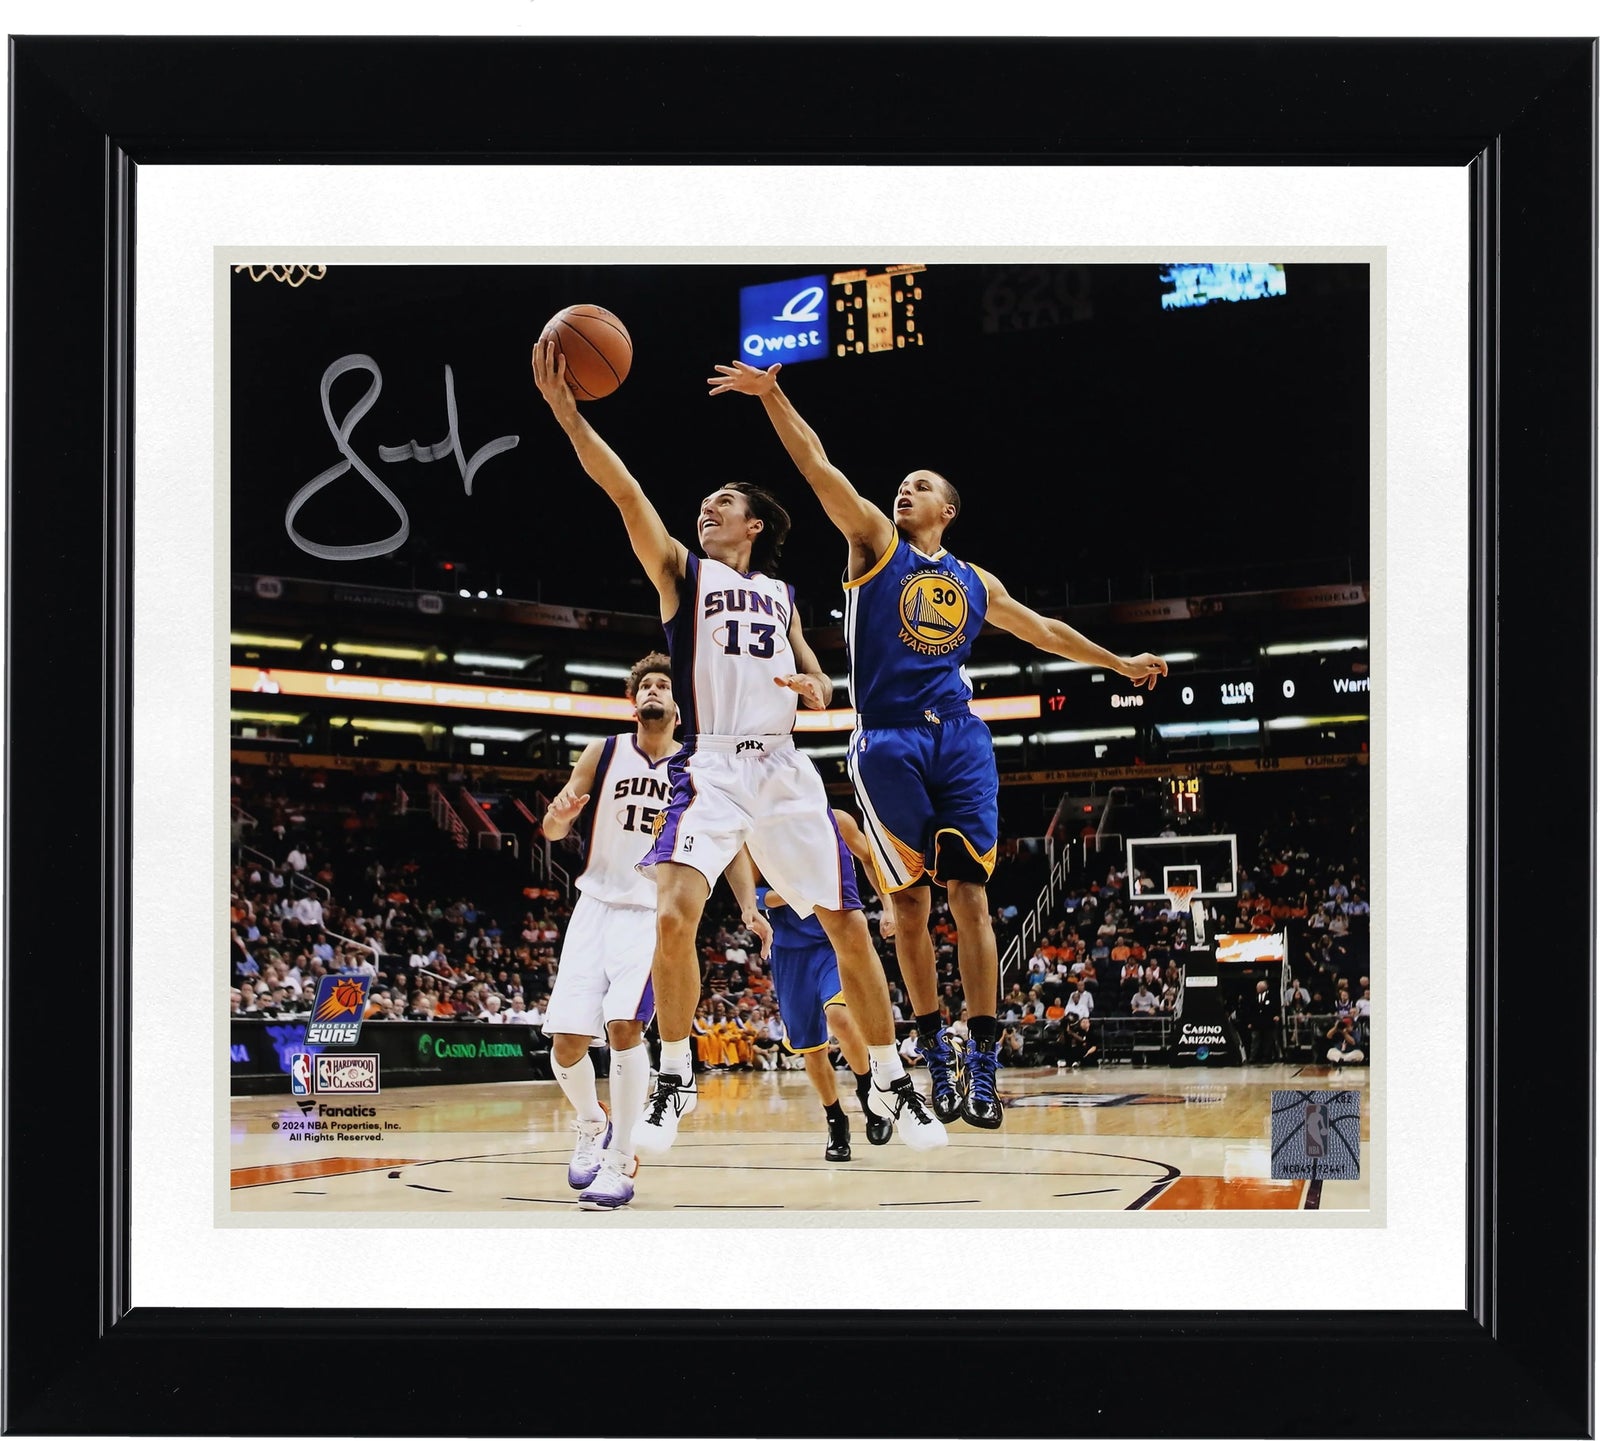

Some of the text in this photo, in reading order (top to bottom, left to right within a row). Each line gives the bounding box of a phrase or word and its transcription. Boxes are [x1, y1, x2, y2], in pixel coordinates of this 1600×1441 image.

[743, 330, 821, 357] Qwest
[900, 568, 970, 594] GOLDEN STATE
[932, 587, 957, 607] 30
[704, 588, 789, 632] SUNS
[722, 619, 777, 660] 13
[897, 626, 967, 657] WARRIORS
[1181, 686, 1195, 705] 0
[1282, 679, 1296, 698] 0
[1049, 695, 1066, 711] 17
[735, 739, 765, 755] PHX
[1314, 754, 1358, 767] LifeLo
[1176, 792, 1197, 813] 17
[623, 804, 661, 835] 15
